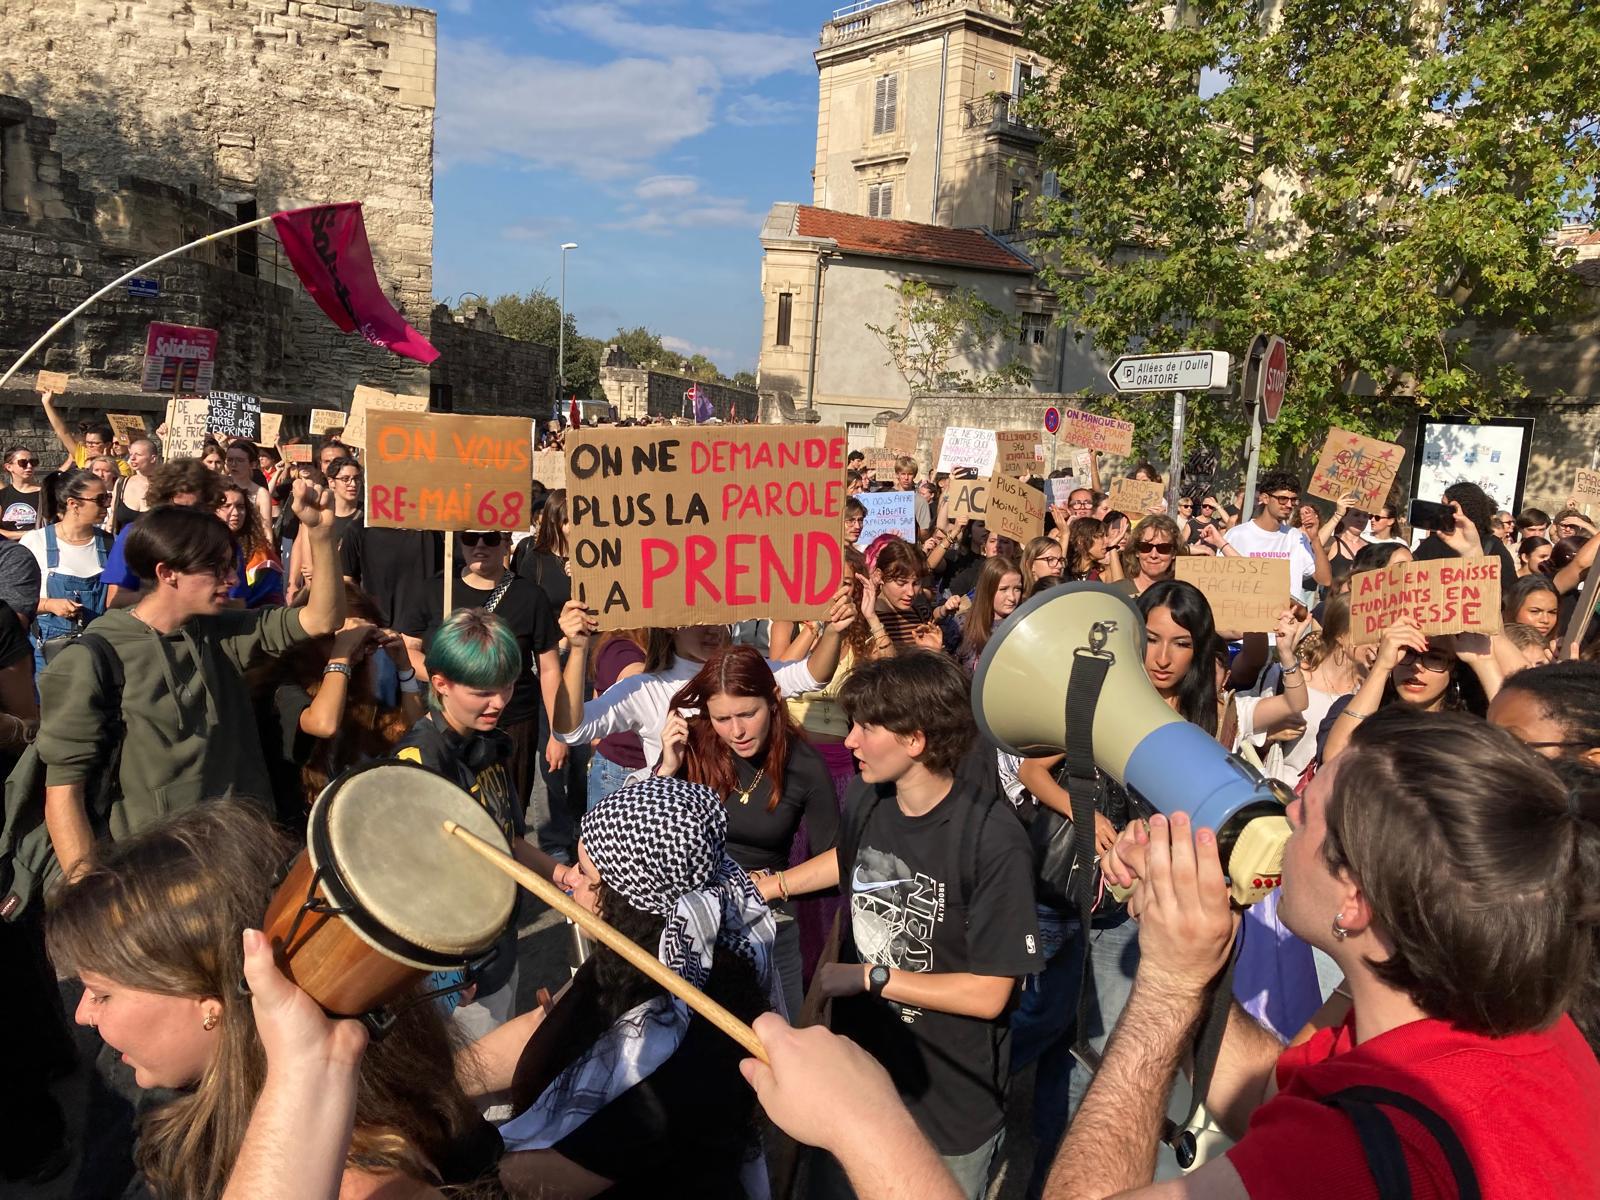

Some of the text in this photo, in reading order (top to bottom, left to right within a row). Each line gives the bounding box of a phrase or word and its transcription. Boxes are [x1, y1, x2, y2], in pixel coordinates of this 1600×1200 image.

[1137, 359, 1209, 373] Allées de l'Oulle
[1136, 373, 1179, 385] ORATOIRE
[1266, 368, 1285, 393] STOP
[178, 401, 190, 414] DE
[207, 391, 245, 402] ELLEMENT
[225, 400, 237, 410] JE
[206, 415, 256, 429] CARTES POUR
[244, 411, 253, 422] DE
[1066, 409, 1132, 432] ON MANQUE NOS
[171, 426, 181, 437] DE
[378, 425, 437, 464] ON
[451, 431, 529, 472] VOUS
[570, 443, 623, 479] ON
[632, 439, 680, 475] NE
[690, 437, 846, 475] DEMANDE
[1336, 449, 1396, 480] QUEERS
[477, 490, 524, 529] 68
[573, 480, 843, 527] PLUS LA PAROLE
[954, 485, 990, 514] AC
[575, 537, 622, 569] ON
[579, 531, 843, 616] LA PREND
[1180, 559, 1270, 575] JEUNESSE
[1360, 570, 1400, 596] APL
[1404, 570, 1429, 584] EN
[1446, 586, 1481, 601] EN
[937, 882, 945, 923] BROOKLYN
